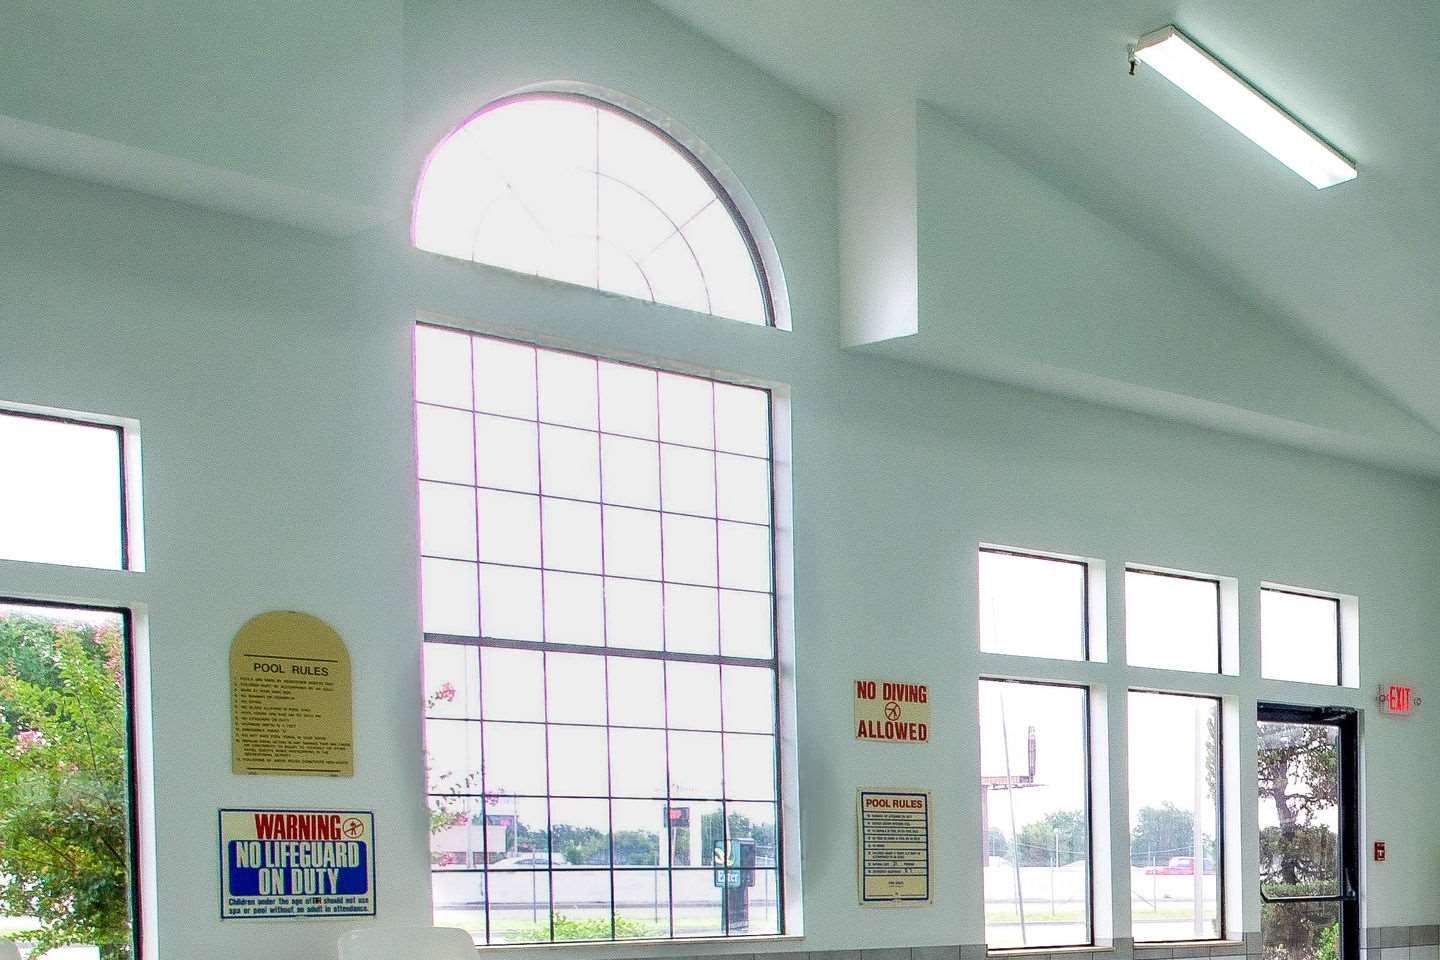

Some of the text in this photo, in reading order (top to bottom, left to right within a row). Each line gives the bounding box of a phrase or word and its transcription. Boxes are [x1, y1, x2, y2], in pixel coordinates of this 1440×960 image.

[254, 663, 329, 676] POOL RULES
[857, 681, 927, 703] NO DIVING
[1390, 687, 1411, 711] EXIT
[858, 720, 927, 740] ALLOWED
[866, 799, 922, 808] POOL RULES
[255, 814, 341, 840] WARNING
[236, 841, 359, 868] NO LIFEGUARD
[258, 868, 339, 895] ON DUTY
[229, 898, 255, 906] Children
[291, 899, 303, 907] age
[324, 897, 343, 905] should
[253, 906, 267, 914] pool
